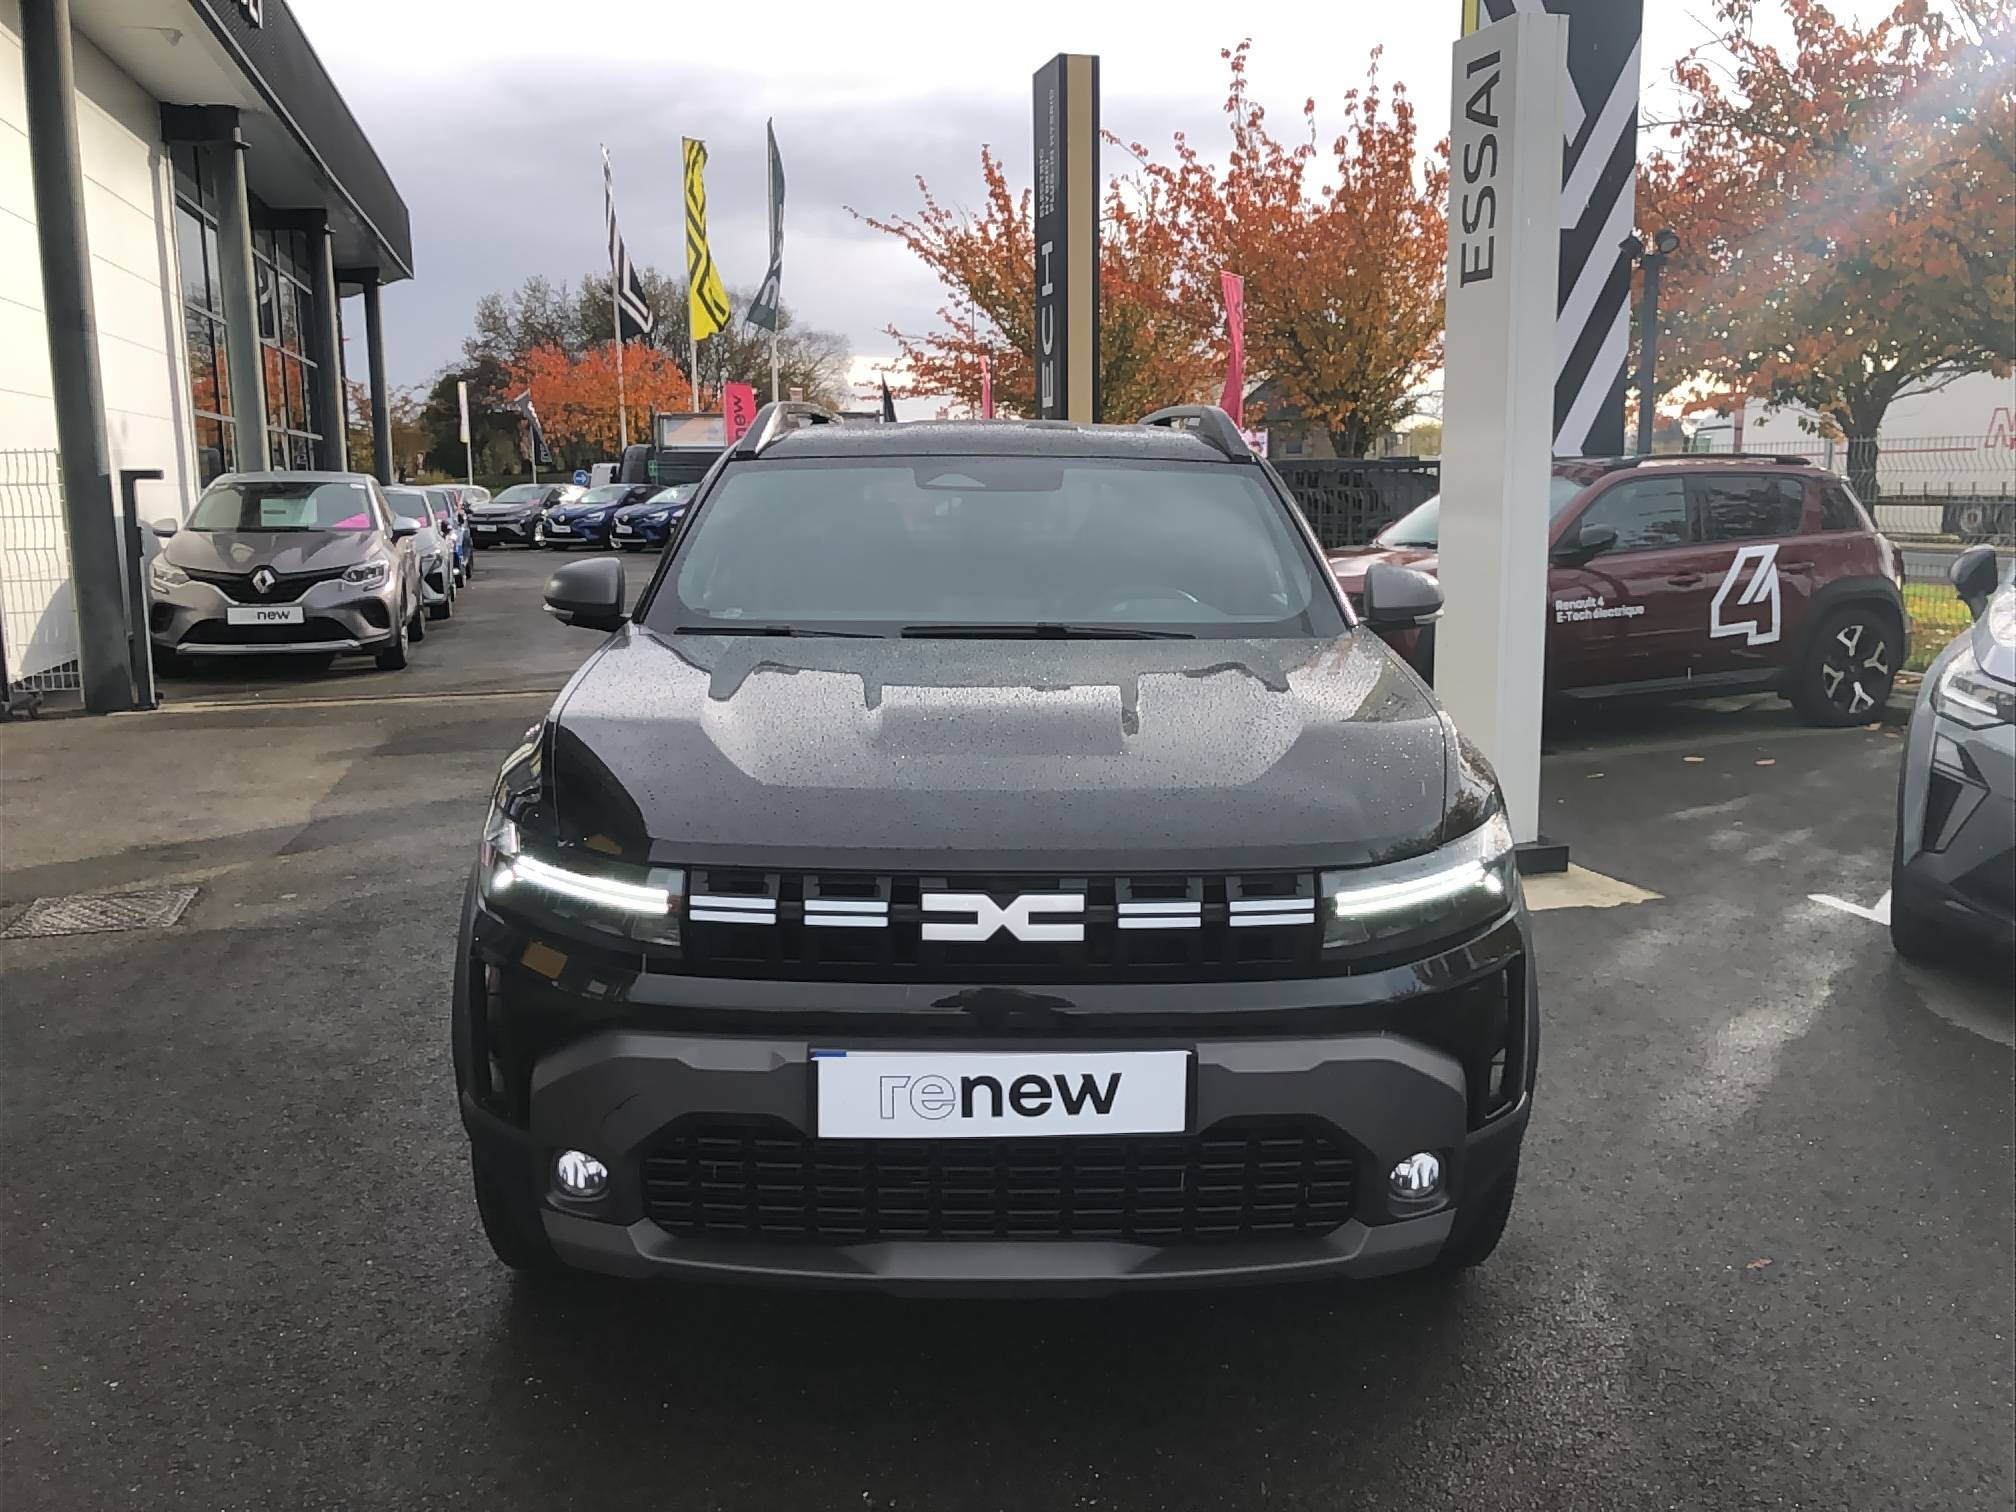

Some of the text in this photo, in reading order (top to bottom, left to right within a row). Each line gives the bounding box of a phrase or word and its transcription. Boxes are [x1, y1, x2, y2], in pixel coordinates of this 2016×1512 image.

[1460, 49, 1501, 288] ESSAI
[1041, 240, 1054, 419] ECH
[256, 610, 291, 620] new
[1555, 595, 1604, 611] Renault 4
[1556, 609, 1592, 623] E-Tech
[879, 1071, 1123, 1120] renew
